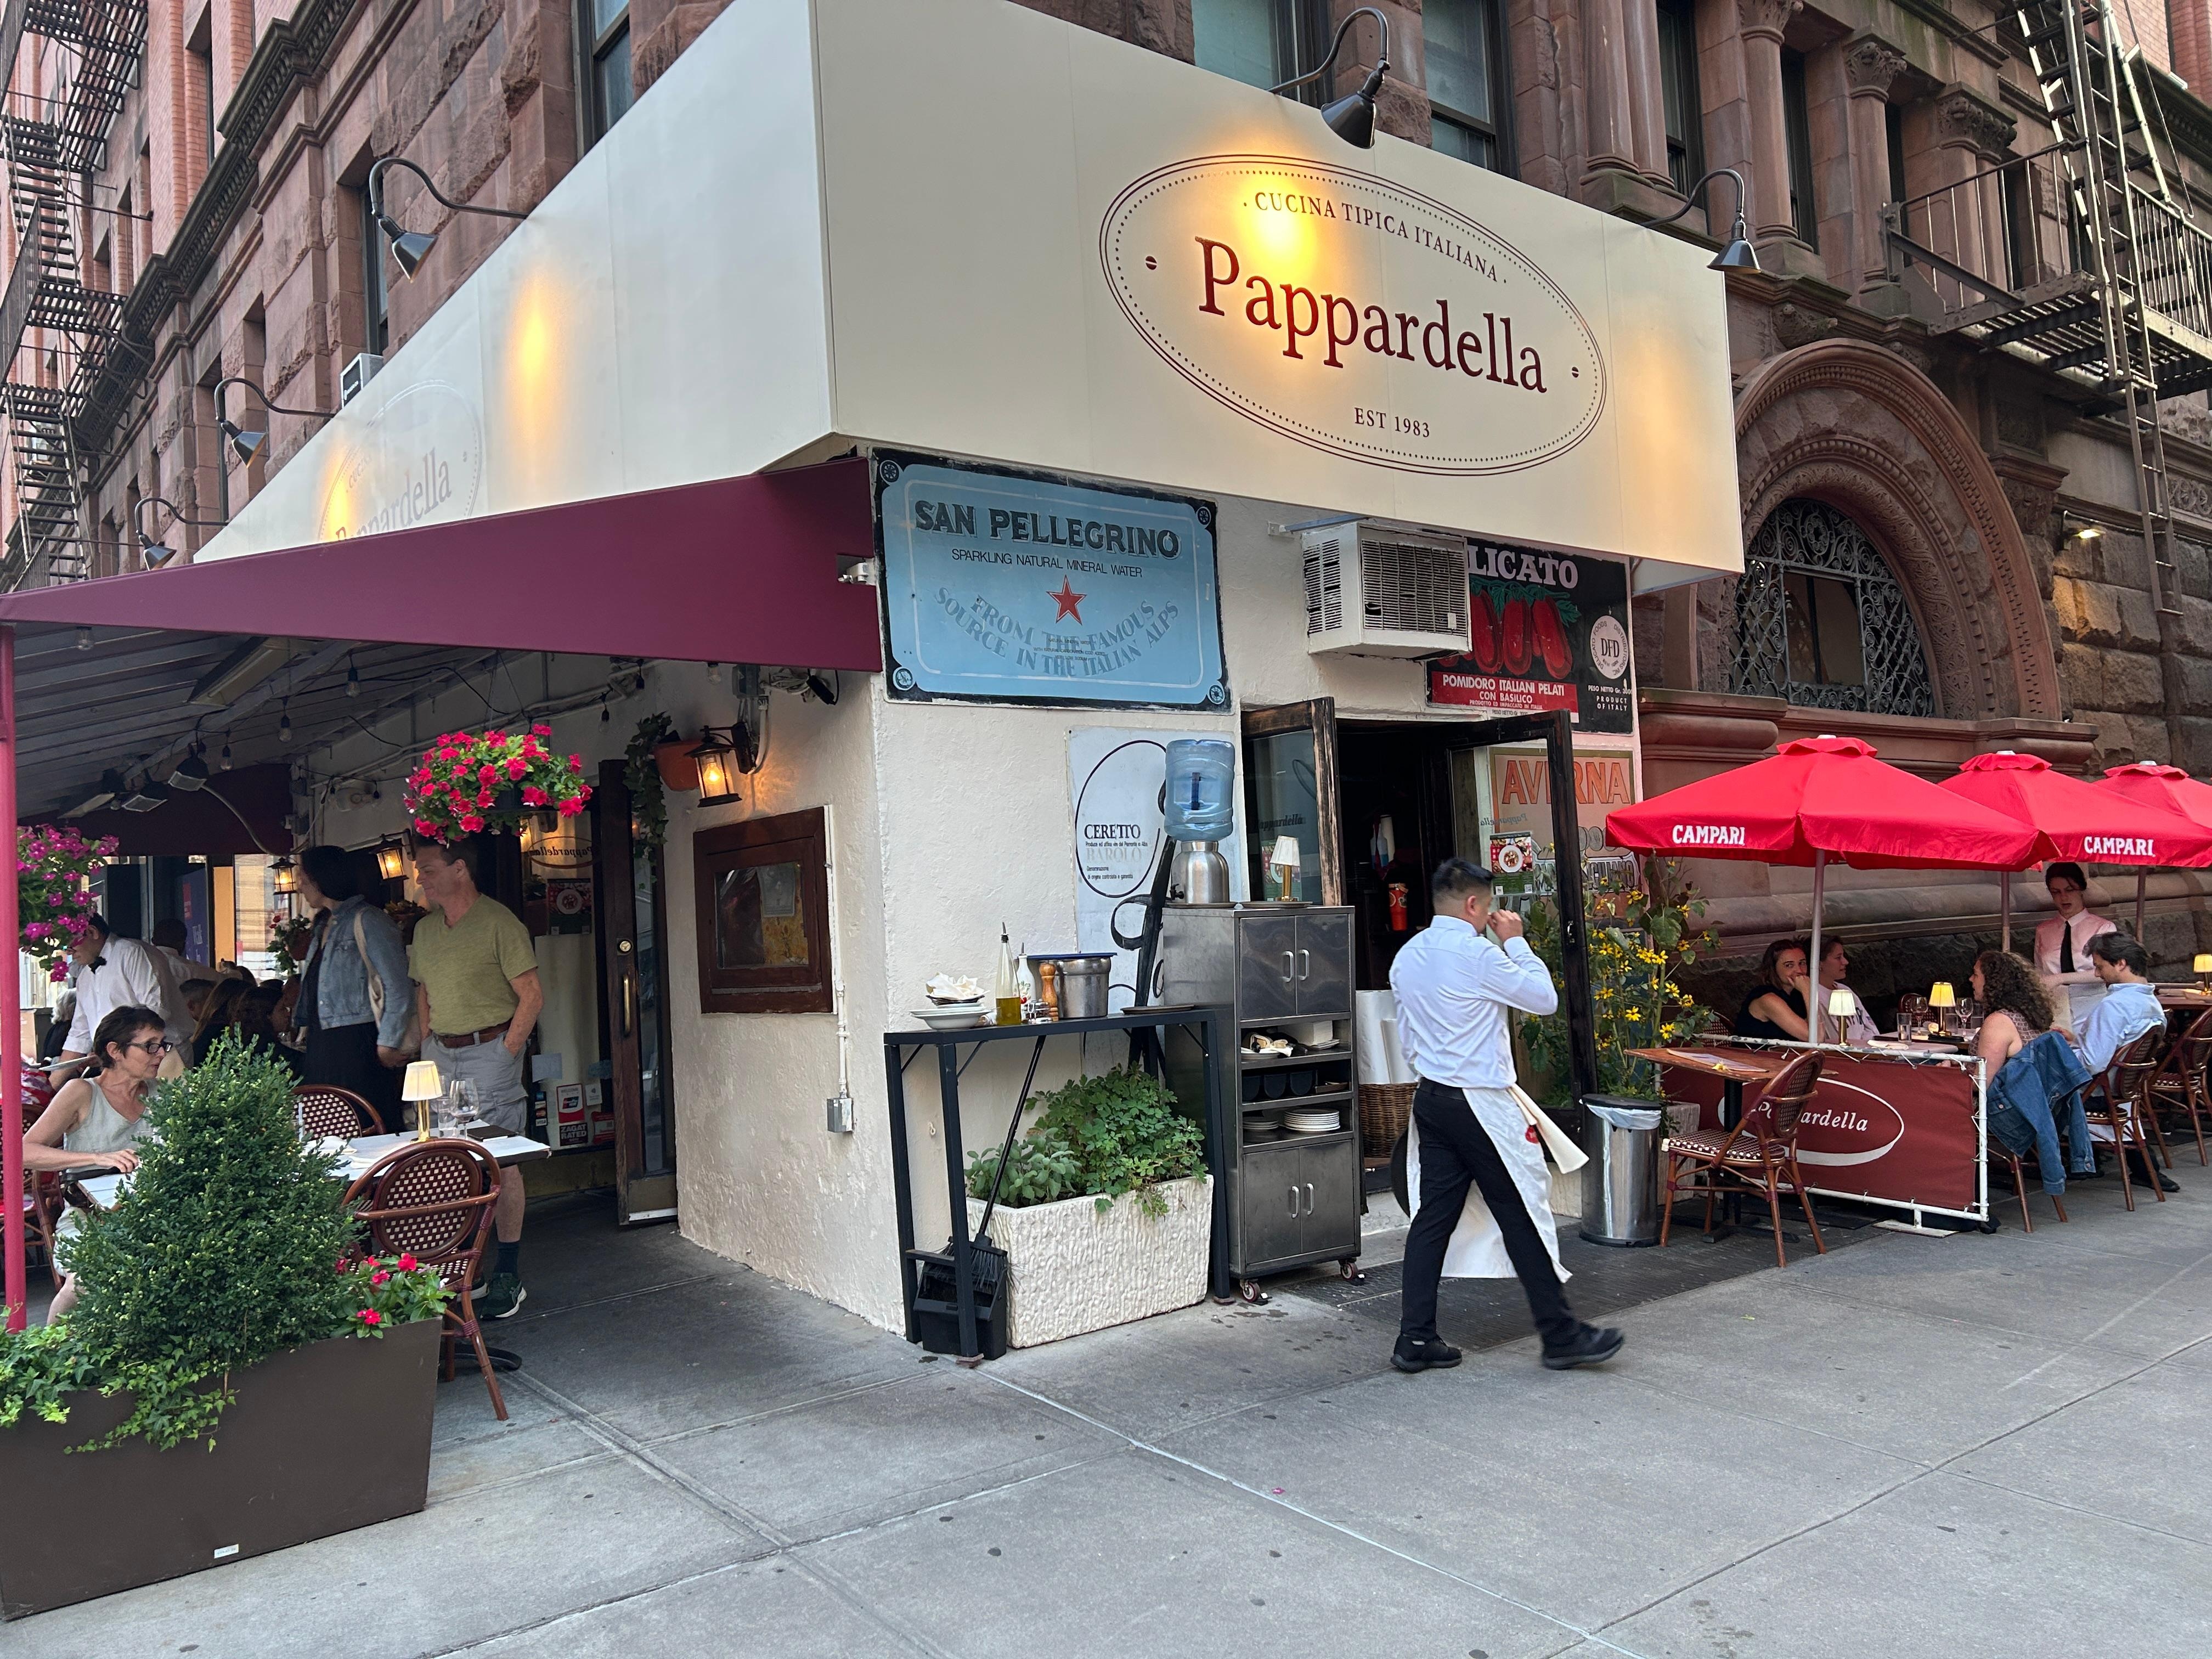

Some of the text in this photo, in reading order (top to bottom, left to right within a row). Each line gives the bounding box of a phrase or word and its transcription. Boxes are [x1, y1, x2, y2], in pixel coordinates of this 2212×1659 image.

[1255, 191, 1498, 282] CUCINA TIPICA ITALIANA
[1195, 236, 1547, 393] Pappardella
[1355, 407, 1430, 438] EST 1983
[336, 447, 452, 541] ardella
[915, 500, 1182, 560] SAN PELLEGRINO
[951, 549, 1142, 578] SPARKLING NATURAL MINERAL WATER
[934, 587, 1180, 677] SOURCE IN THE ITALIAN ALPS
[970, 594, 1154, 652] FROM THE FAMOUS
[1593, 620, 1608, 636] FOODS
[1591, 637, 1604, 670] DELICATO
[1601, 638, 1620, 658] DFD
[1442, 674, 1565, 696] POMIDORO ITALIANI PELATI
[1479, 691, 1533, 704] CON BASILICO
[1596, 695, 1628, 704] PRODUCT
[1084, 823, 1141, 839] CERETTO
[1256, 814, 1304, 832] appardella
[1672, 825, 1745, 845] CAMPARI
[1087, 847, 1142, 863] BAROLO
[2084, 836, 2154, 856] CAMPARI
[1757, 1101, 1868, 1132] Pardella
[560, 1124, 586, 1133] ZAGAT
[561, 1130, 587, 1139] RATED
